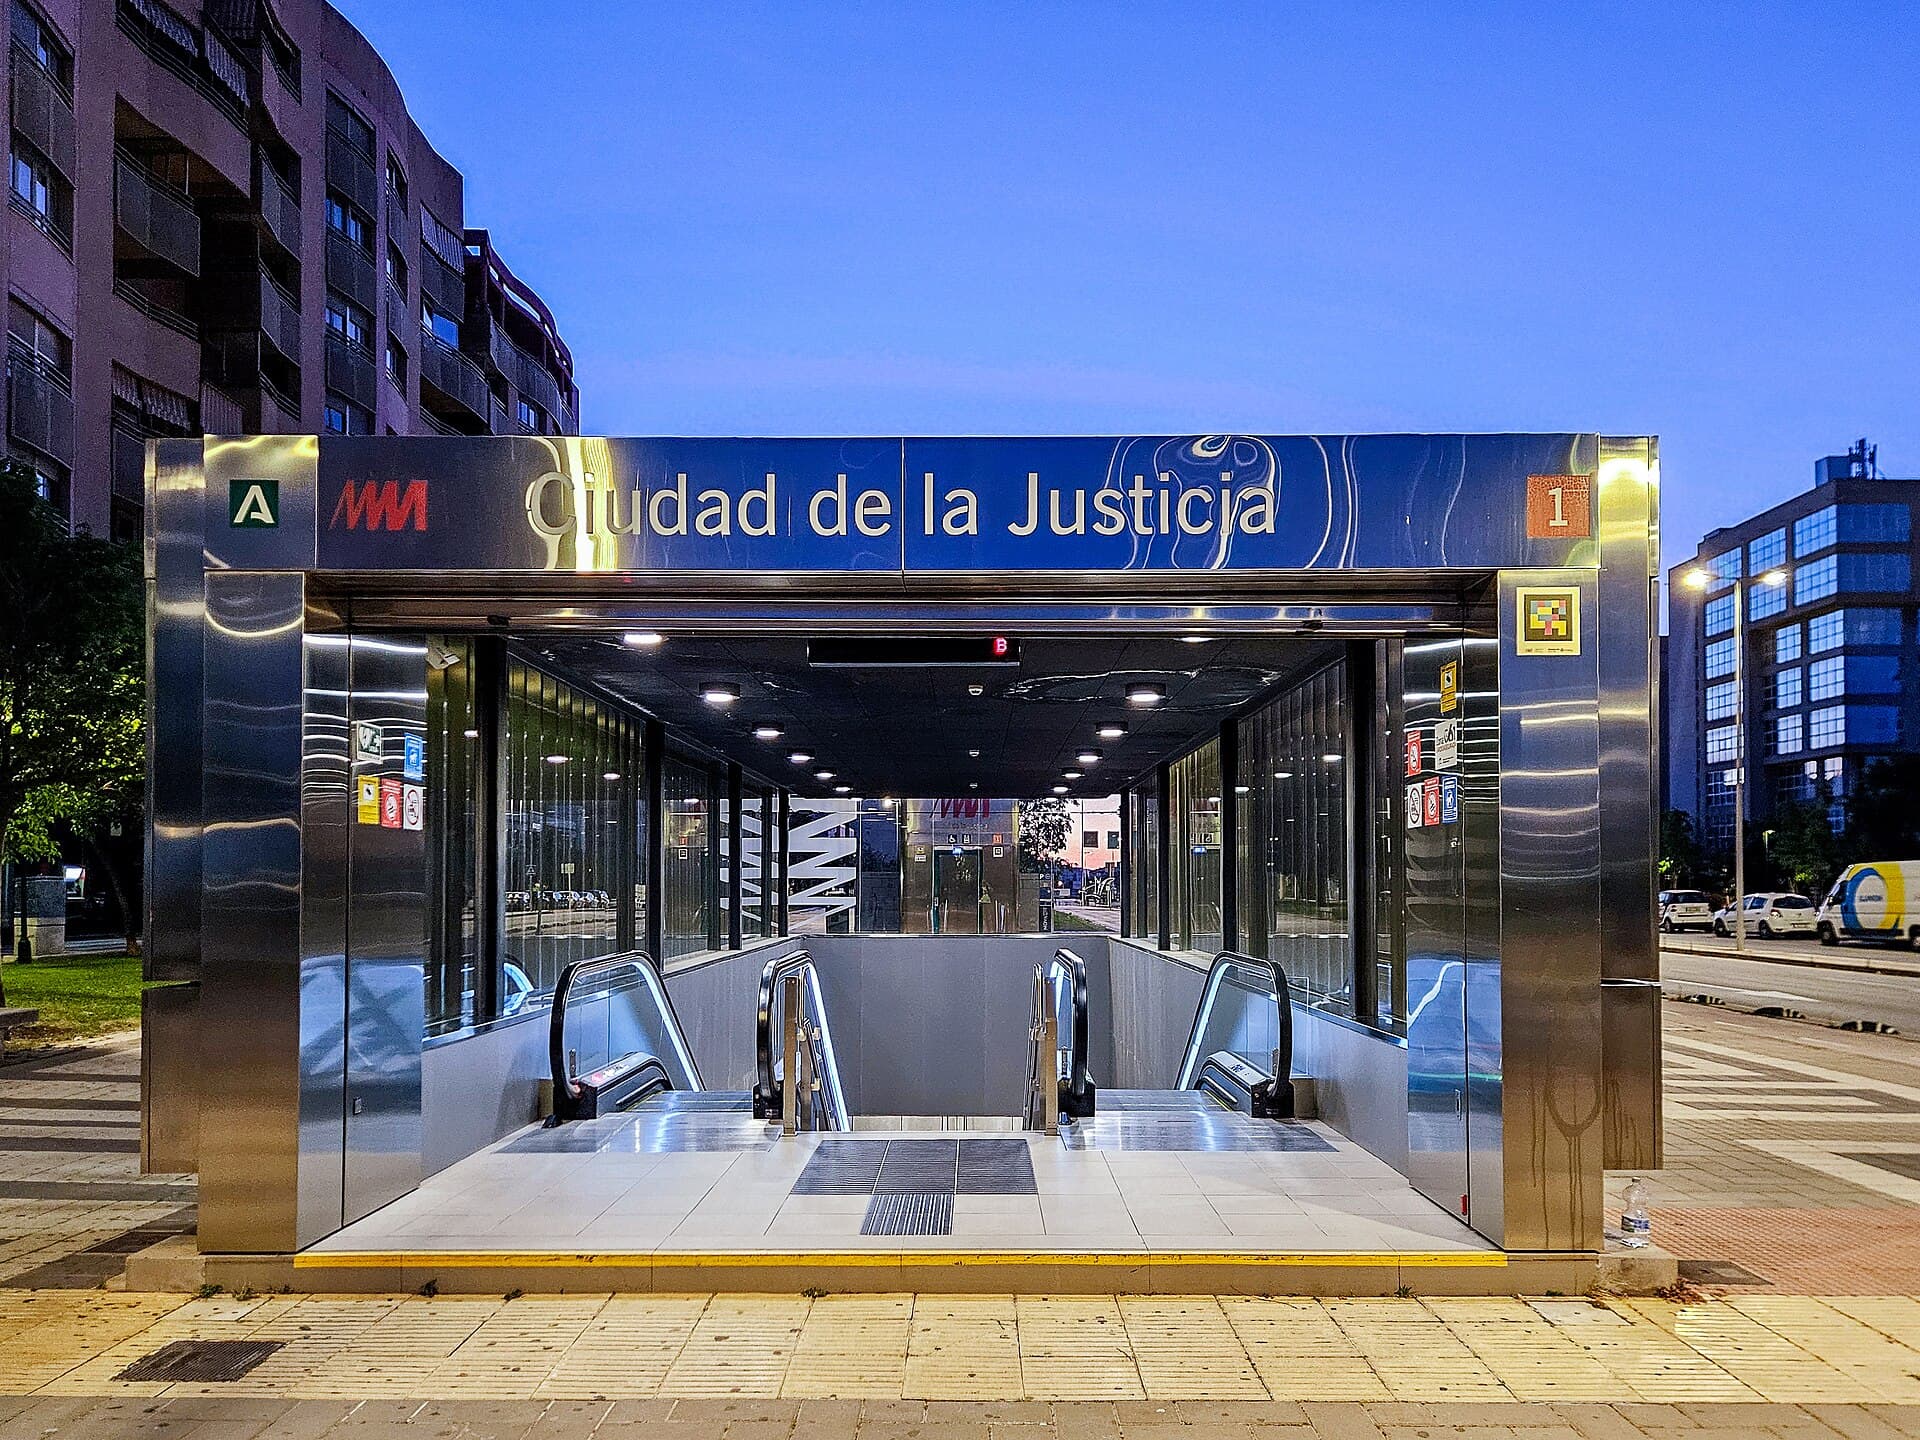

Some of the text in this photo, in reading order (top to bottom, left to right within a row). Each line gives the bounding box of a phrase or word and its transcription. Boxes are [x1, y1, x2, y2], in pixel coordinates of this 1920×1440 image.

[529, 472, 1275, 536] Ciudad de la Justicia
[1548, 487, 1568, 527] 1
